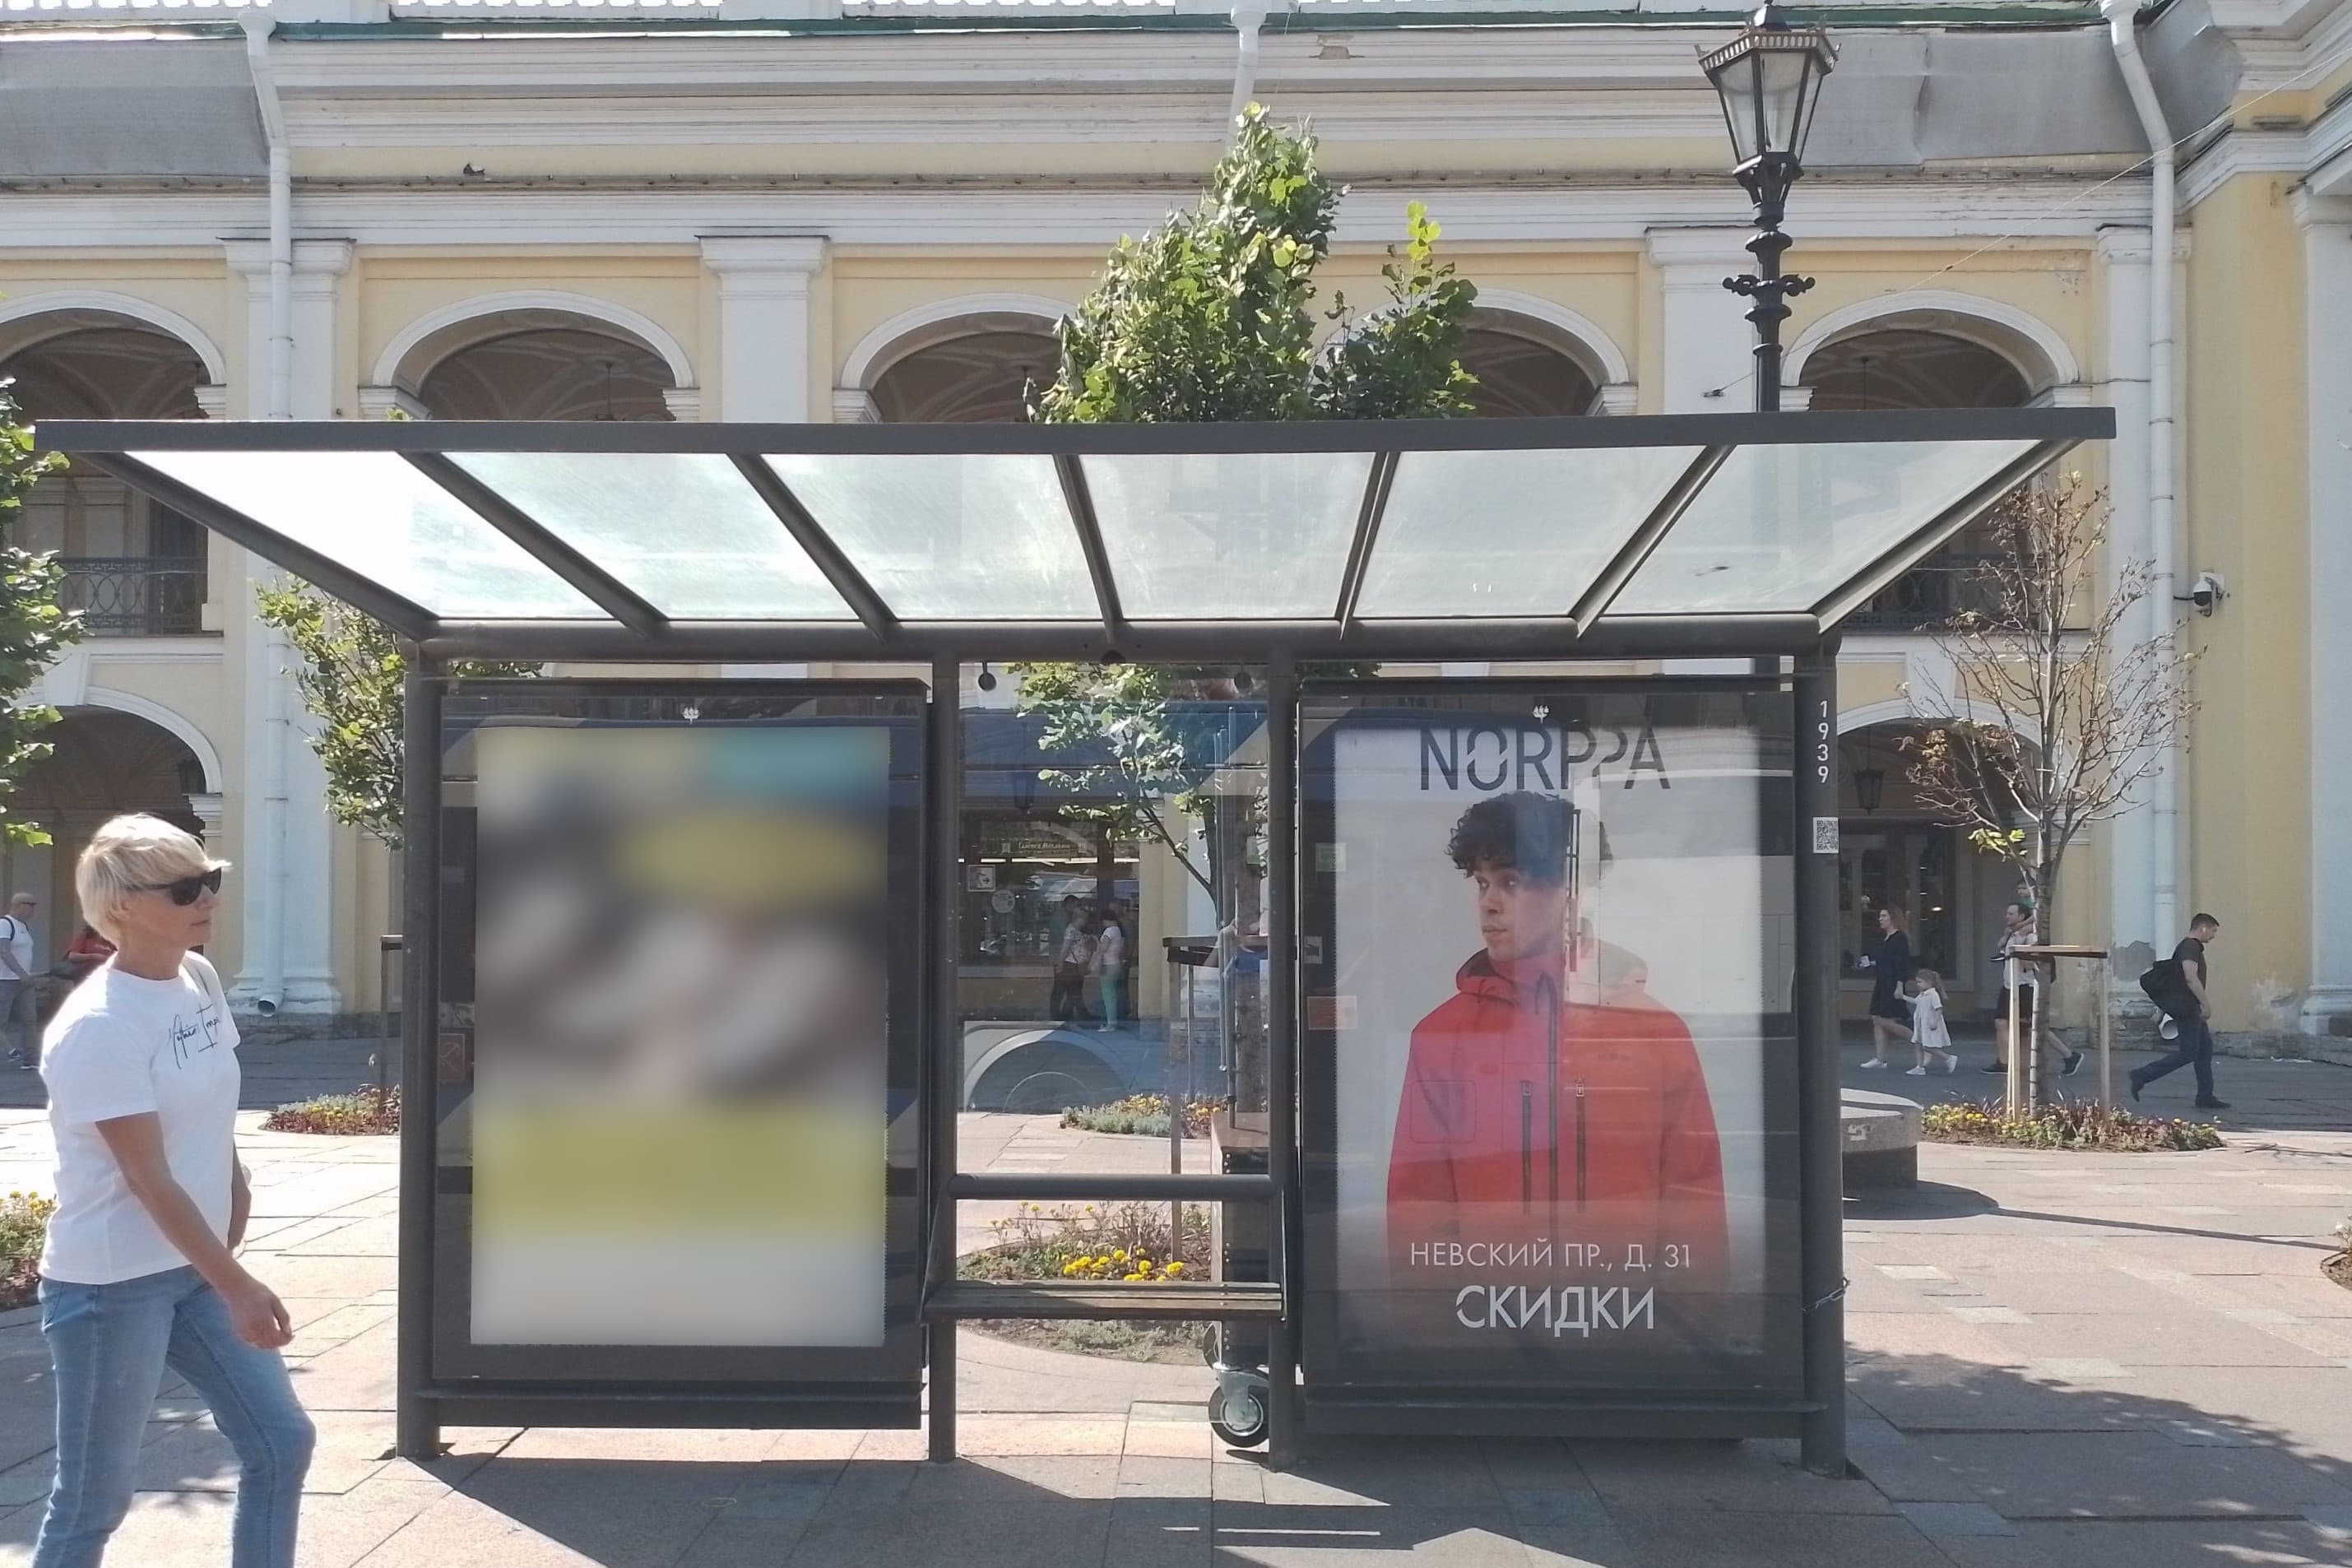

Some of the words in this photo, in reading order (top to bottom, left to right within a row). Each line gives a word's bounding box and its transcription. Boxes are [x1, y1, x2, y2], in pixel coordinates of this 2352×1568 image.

[1419, 725, 1672, 791] NORPPA
[1817, 699, 1829, 784] 1939
[1409, 1237, 1553, 1267] НЕВСКИЙ
[1564, 1243, 1614, 1272] ПР.,
[1624, 1243, 1653, 1272] Д.
[1664, 1243, 1691, 1269] 31
[1455, 1284, 1655, 1338] СКИДКИ
